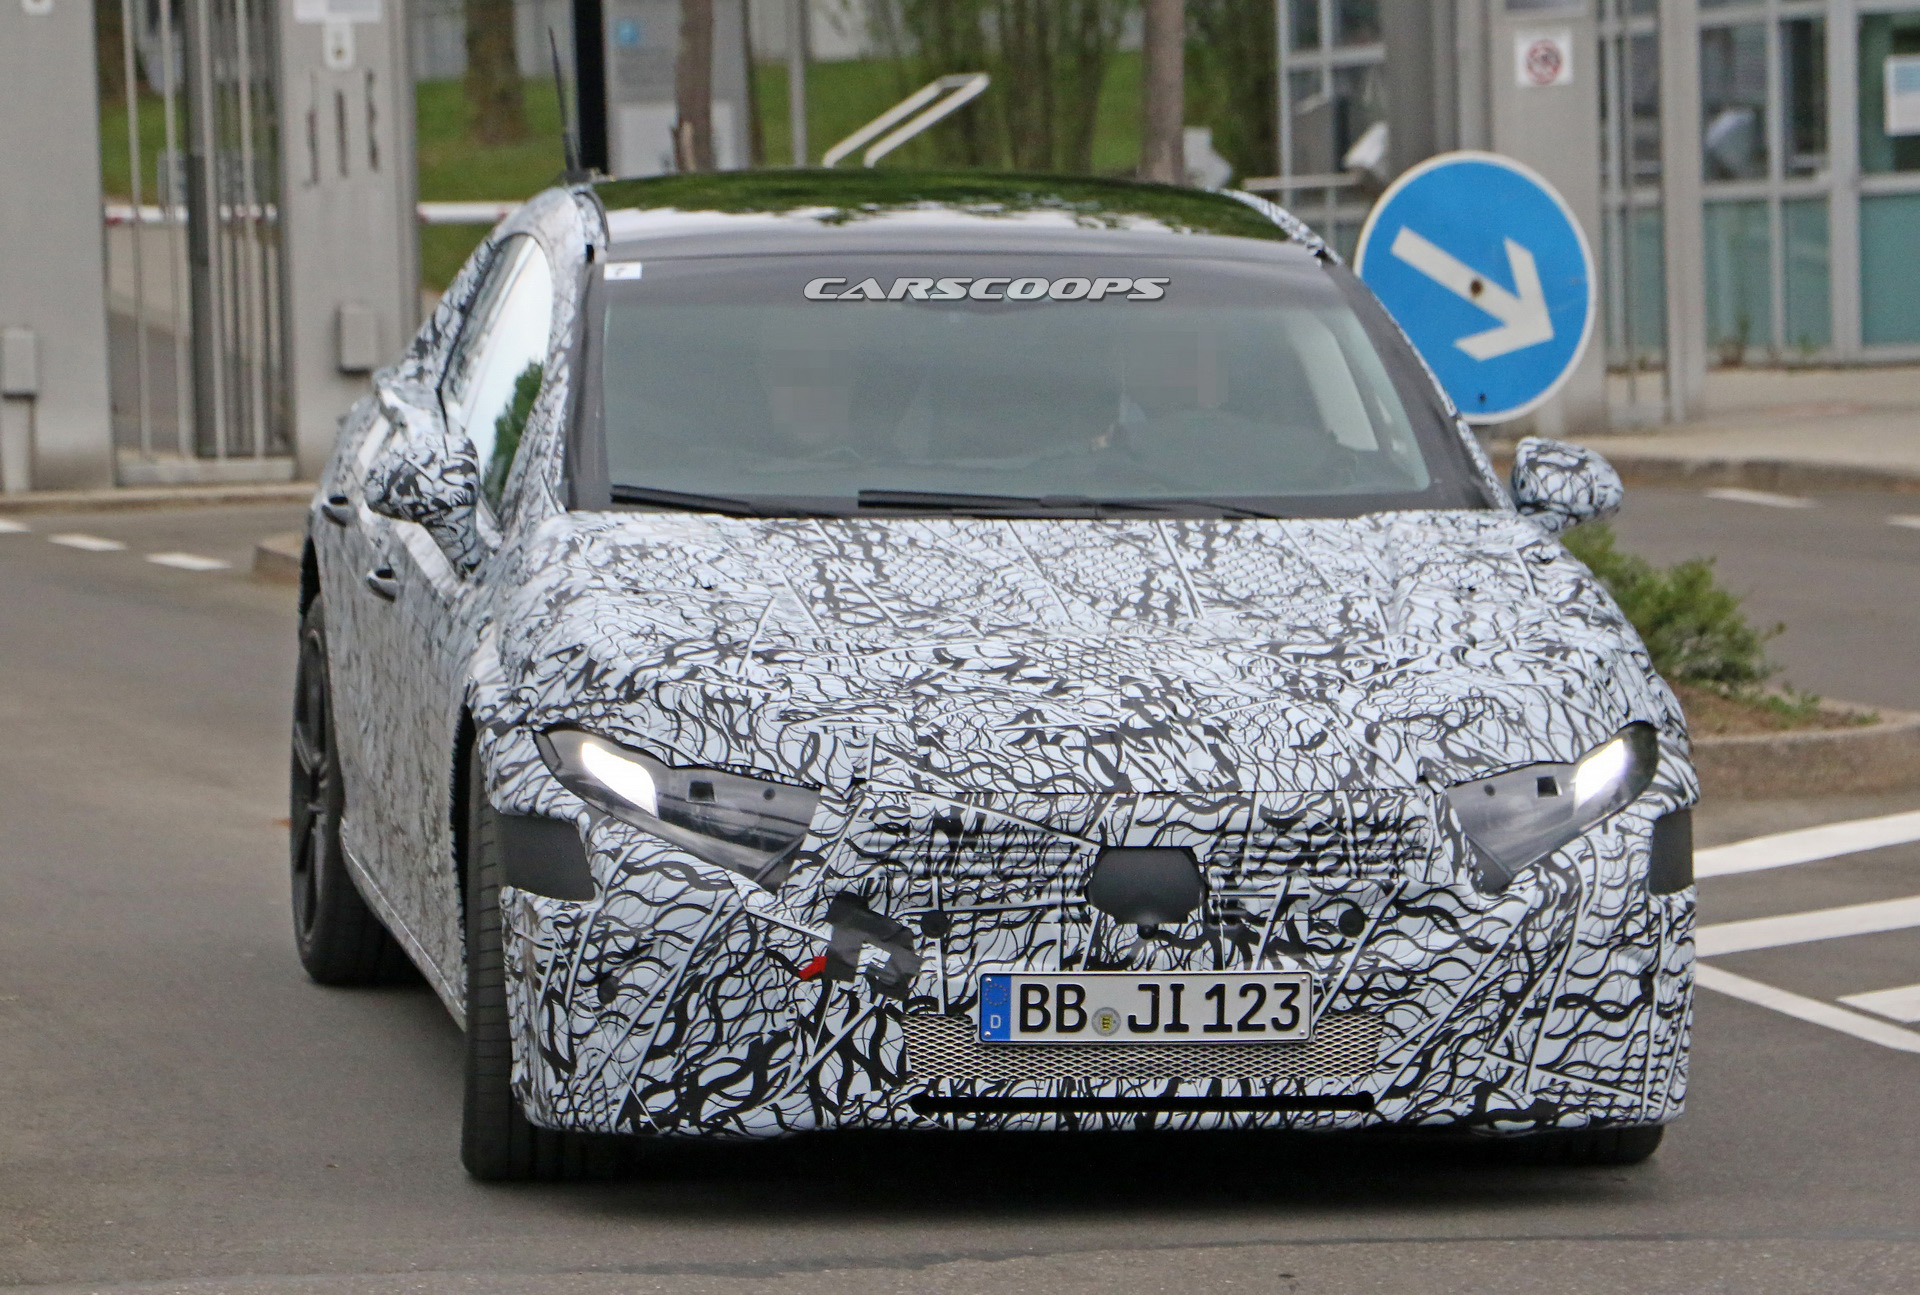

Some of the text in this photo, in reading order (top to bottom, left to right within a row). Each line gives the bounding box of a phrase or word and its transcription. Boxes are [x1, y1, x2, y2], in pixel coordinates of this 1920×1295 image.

[990, 1014, 1001, 1029] D
[1019, 983, 1301, 1033] BB JI 123
